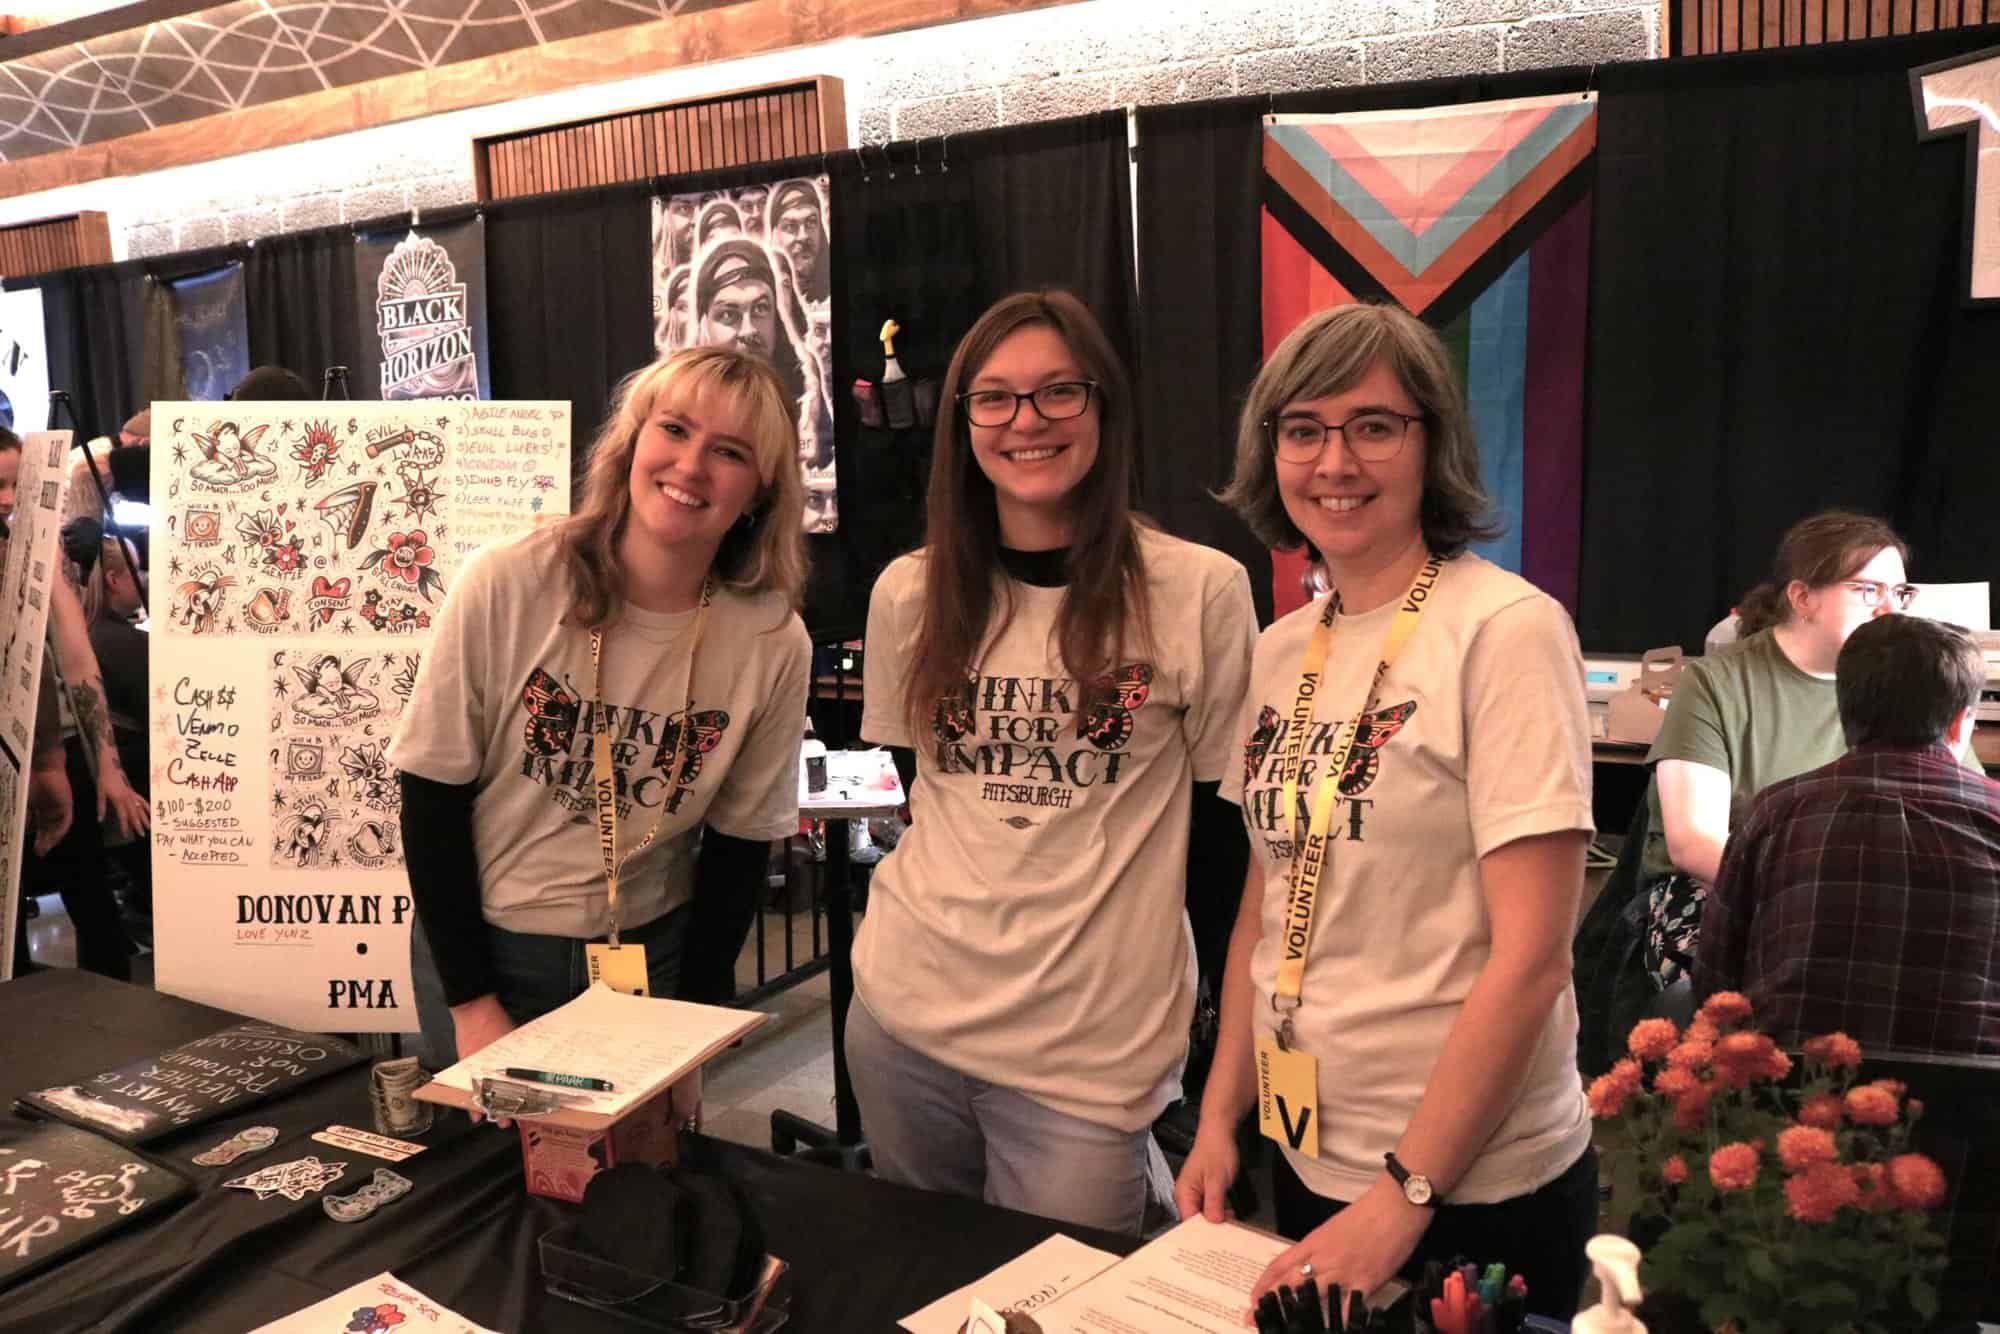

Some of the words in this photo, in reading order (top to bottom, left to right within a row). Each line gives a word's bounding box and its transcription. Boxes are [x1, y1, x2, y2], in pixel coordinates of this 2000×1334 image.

[382, 296, 462, 329] BLACK
[380, 327, 472, 385] HORIZON
[366, 424, 400, 441] EVIL
[308, 599, 348, 610] CONSENT
[387, 623, 414, 634] HAPPY
[174, 677, 213, 711] CASH
[980, 676, 1079, 714] INK
[177, 708, 239, 736] VENMO
[989, 715, 1059, 742] FOR
[1285, 671, 1319, 782] VOLUNTEER
[185, 738, 237, 767] ZELLE
[982, 782, 1073, 808] PITTSBURGH
[173, 817, 240, 828] SUGGESTED
[598, 778, 614, 880] VOLUNTEER
[156, 833, 174, 847] PAY
[180, 834, 205, 845] WHAT
[208, 836, 228, 847] YOU
[182, 848, 240, 862] ACCEPTED
[237, 895, 381, 924] DONOVAN
[1286, 834, 1323, 960] VOLUNTEER
[236, 928, 266, 940] LOVE
[328, 979, 398, 1008] PMA
[141, 1065, 240, 1104] NEITHER
[1261, 1051, 1271, 1120] VOLUNTEER
[1275, 1094, 1312, 1151] V
